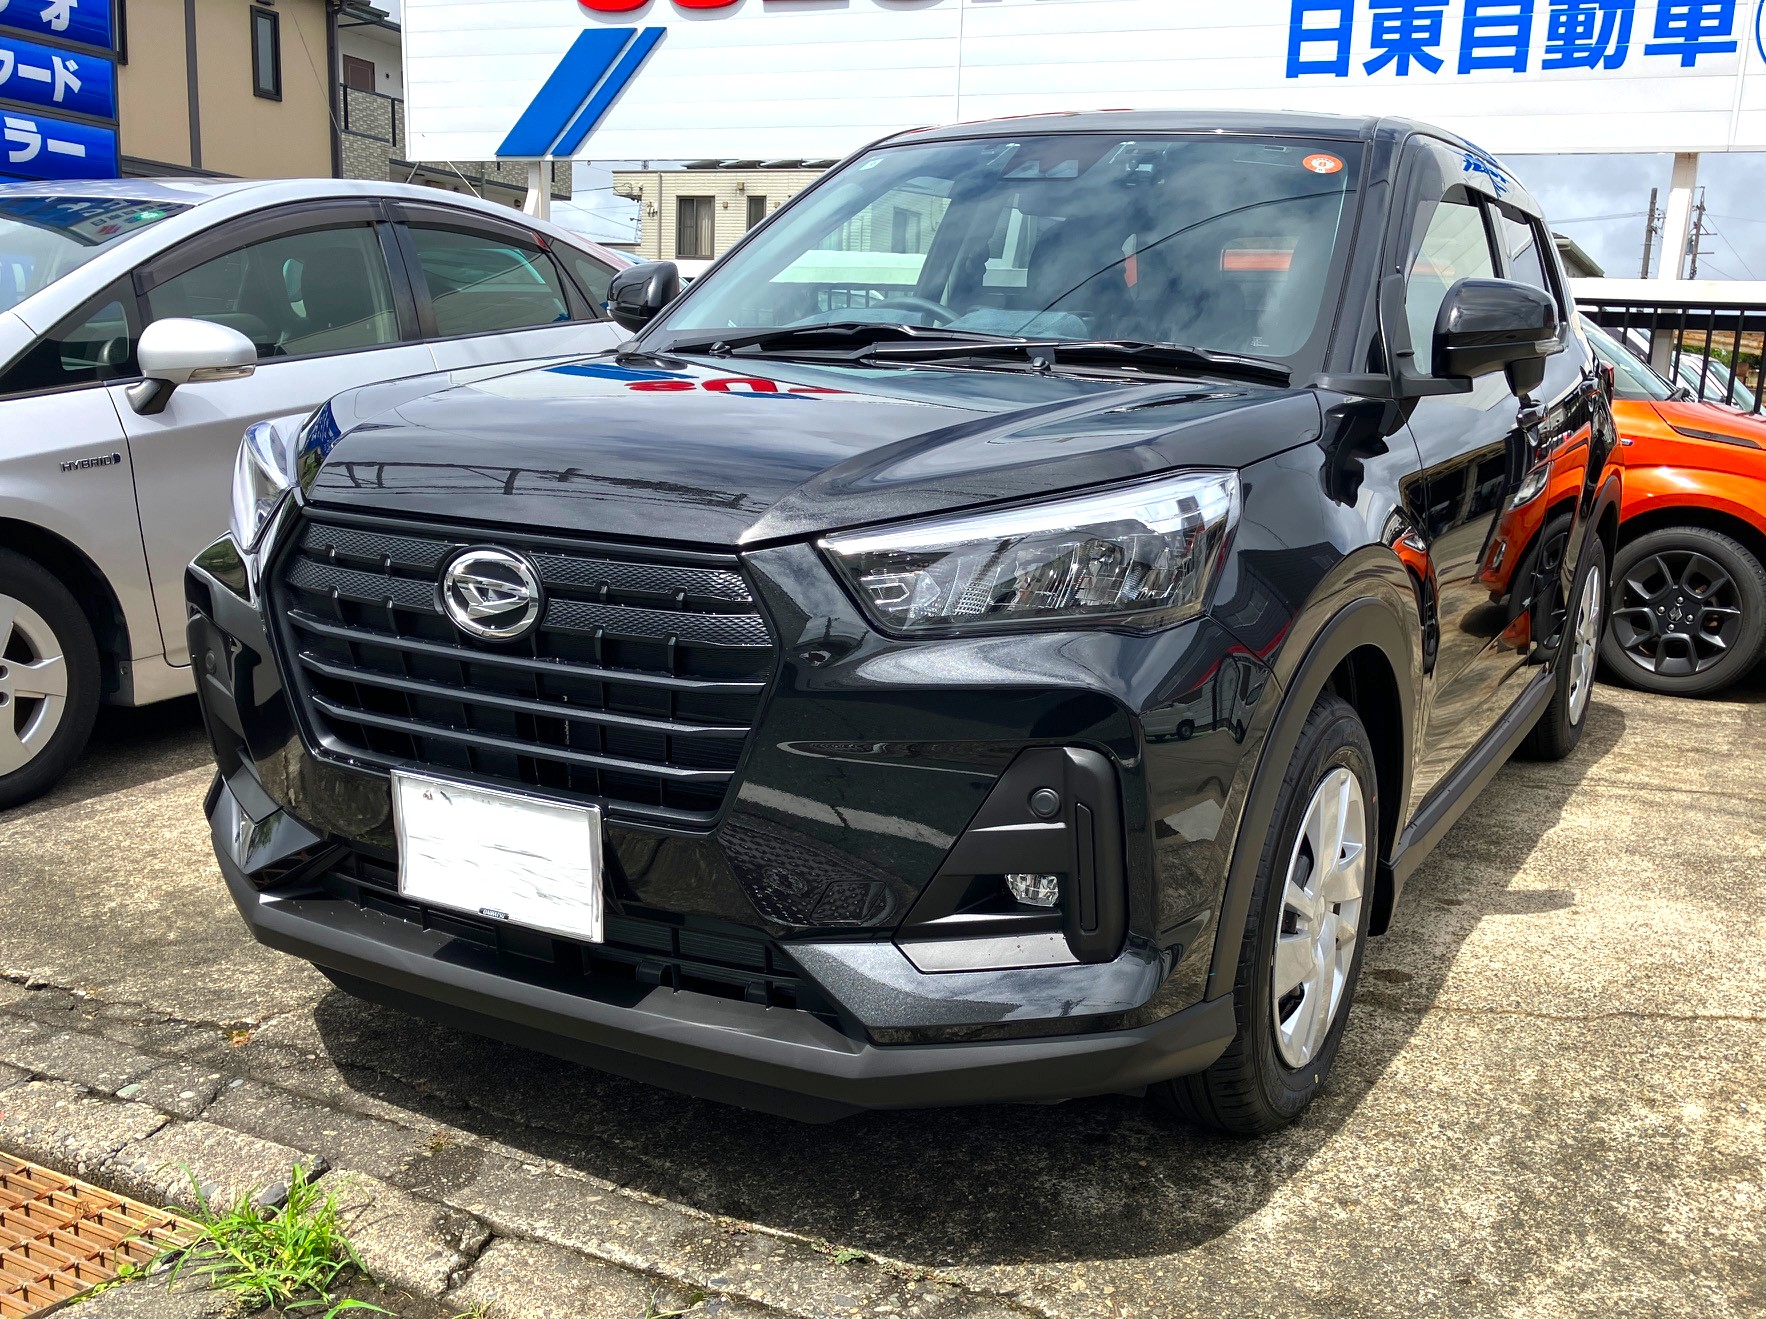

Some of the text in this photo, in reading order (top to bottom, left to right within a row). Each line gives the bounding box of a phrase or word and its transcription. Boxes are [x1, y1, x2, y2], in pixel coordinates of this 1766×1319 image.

[1285, 0, 1738, 79] 日東自動車
[4, 116, 87, 163] ラー
[60, 455, 112, 472] HYBRID
